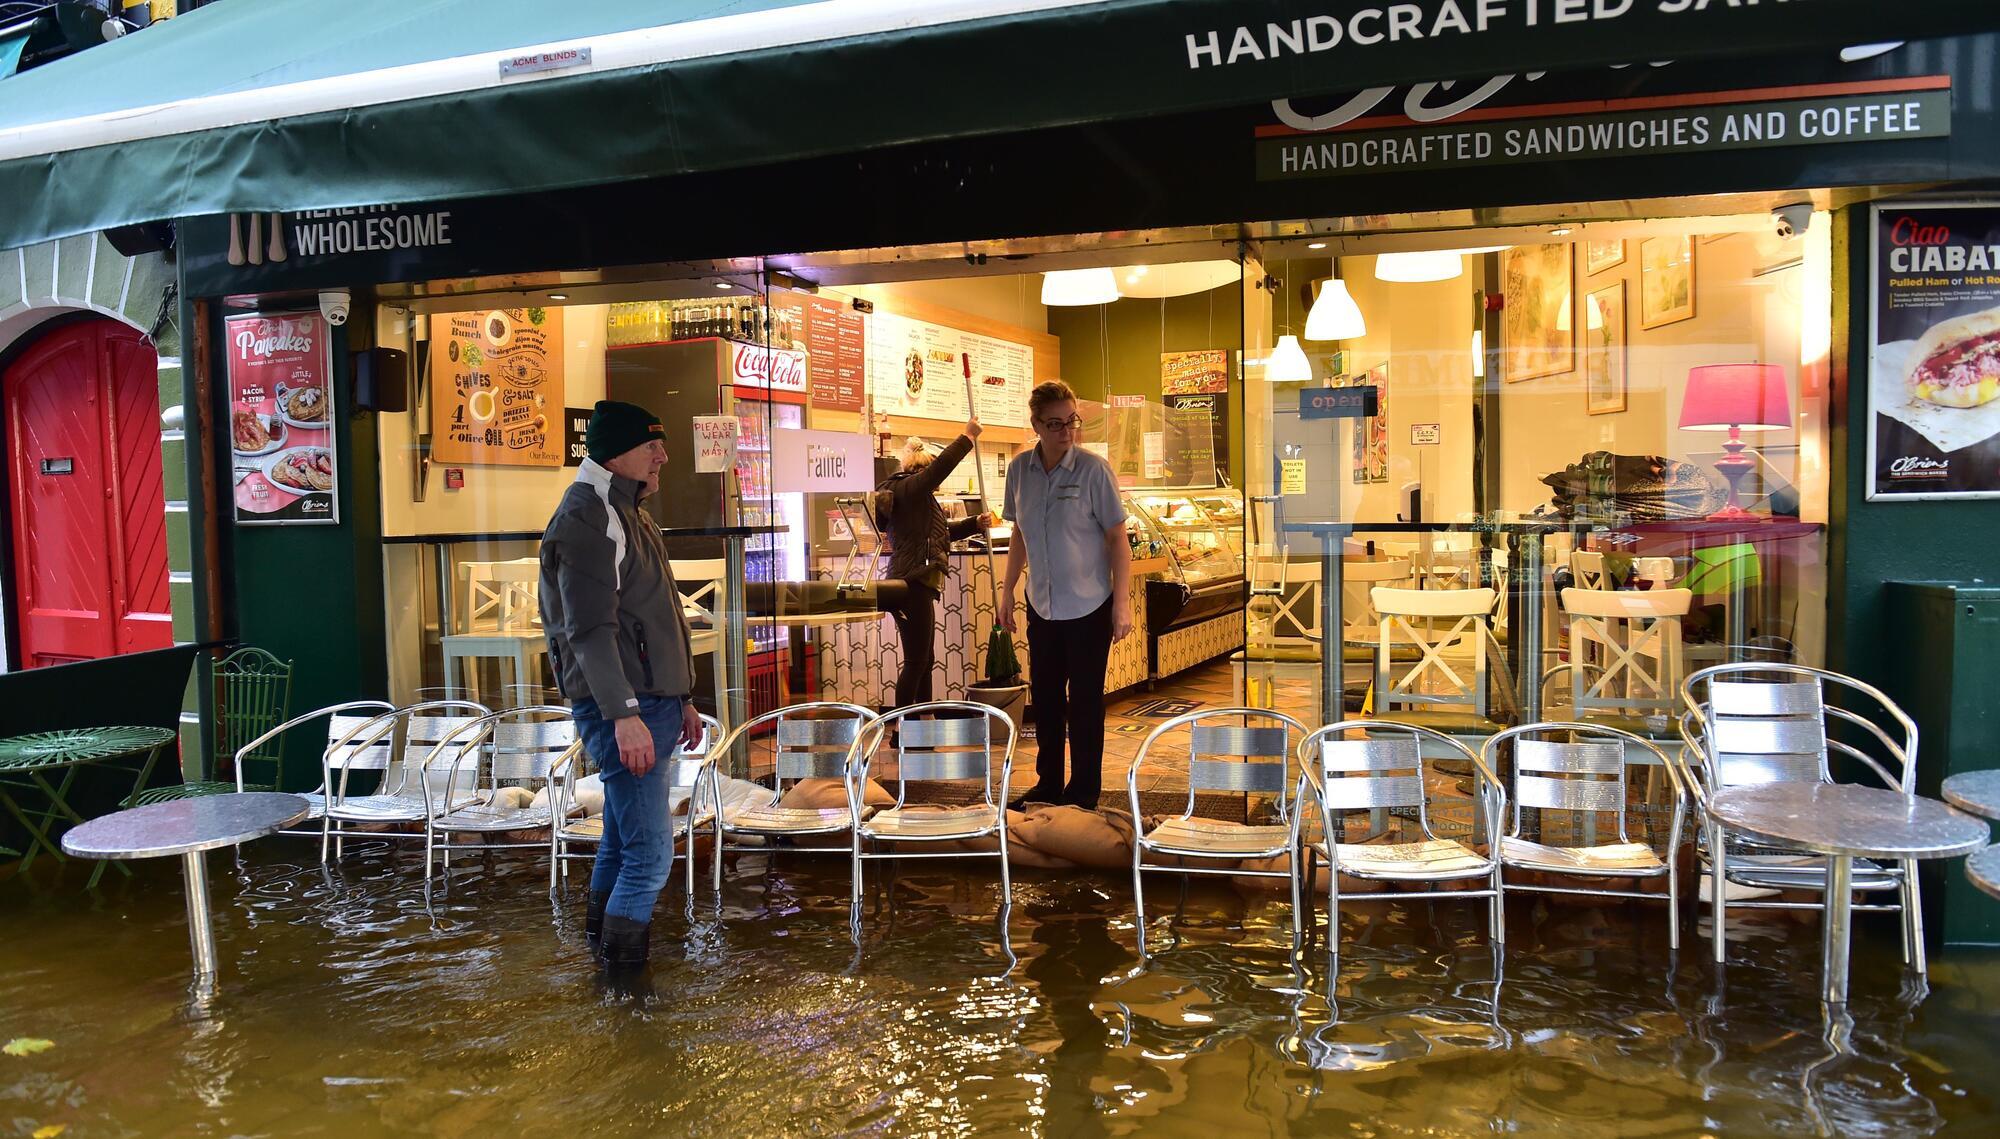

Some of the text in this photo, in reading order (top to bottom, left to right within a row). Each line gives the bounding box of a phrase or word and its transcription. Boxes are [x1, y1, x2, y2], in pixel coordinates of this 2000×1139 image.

[1186, 0, 1634, 69] HANDCRAFTED
[512, 50, 577, 67] ACME BLINDS
[1281, 102, 1921, 172] HANDCRAFTED SANDWICHES AND COFFEE
[295, 211, 453, 256] WHOLESOME
[1890, 216, 1951, 246] Ciao
[1889, 277, 1923, 287] Pulled
[1926, 277, 1949, 286] Ham
[1965, 276, 1985, 285] Hot
[450, 317, 478, 329] Small
[451, 327, 482, 339] Bunch
[531, 337, 544, 345] and
[235, 328, 313, 359] Pancakes
[1164, 352, 1223, 372] specially
[1181, 365, 1208, 377] made
[455, 371, 491, 389] CHIVES
[1174, 373, 1217, 389] for you
[517, 389, 535, 400] SALT
[1311, 393, 1363, 412] open
[450, 404, 464, 423] 4
[503, 406, 530, 418] DRIZZLE
[457, 428, 504, 447] Olive OIL
[508, 431, 546, 450] honey
[702, 431, 732, 440] WEAR
[713, 440, 721, 449] A
[529, 451, 561, 462] Our Recipe
[1890, 456, 1949, 472] O'Briens
